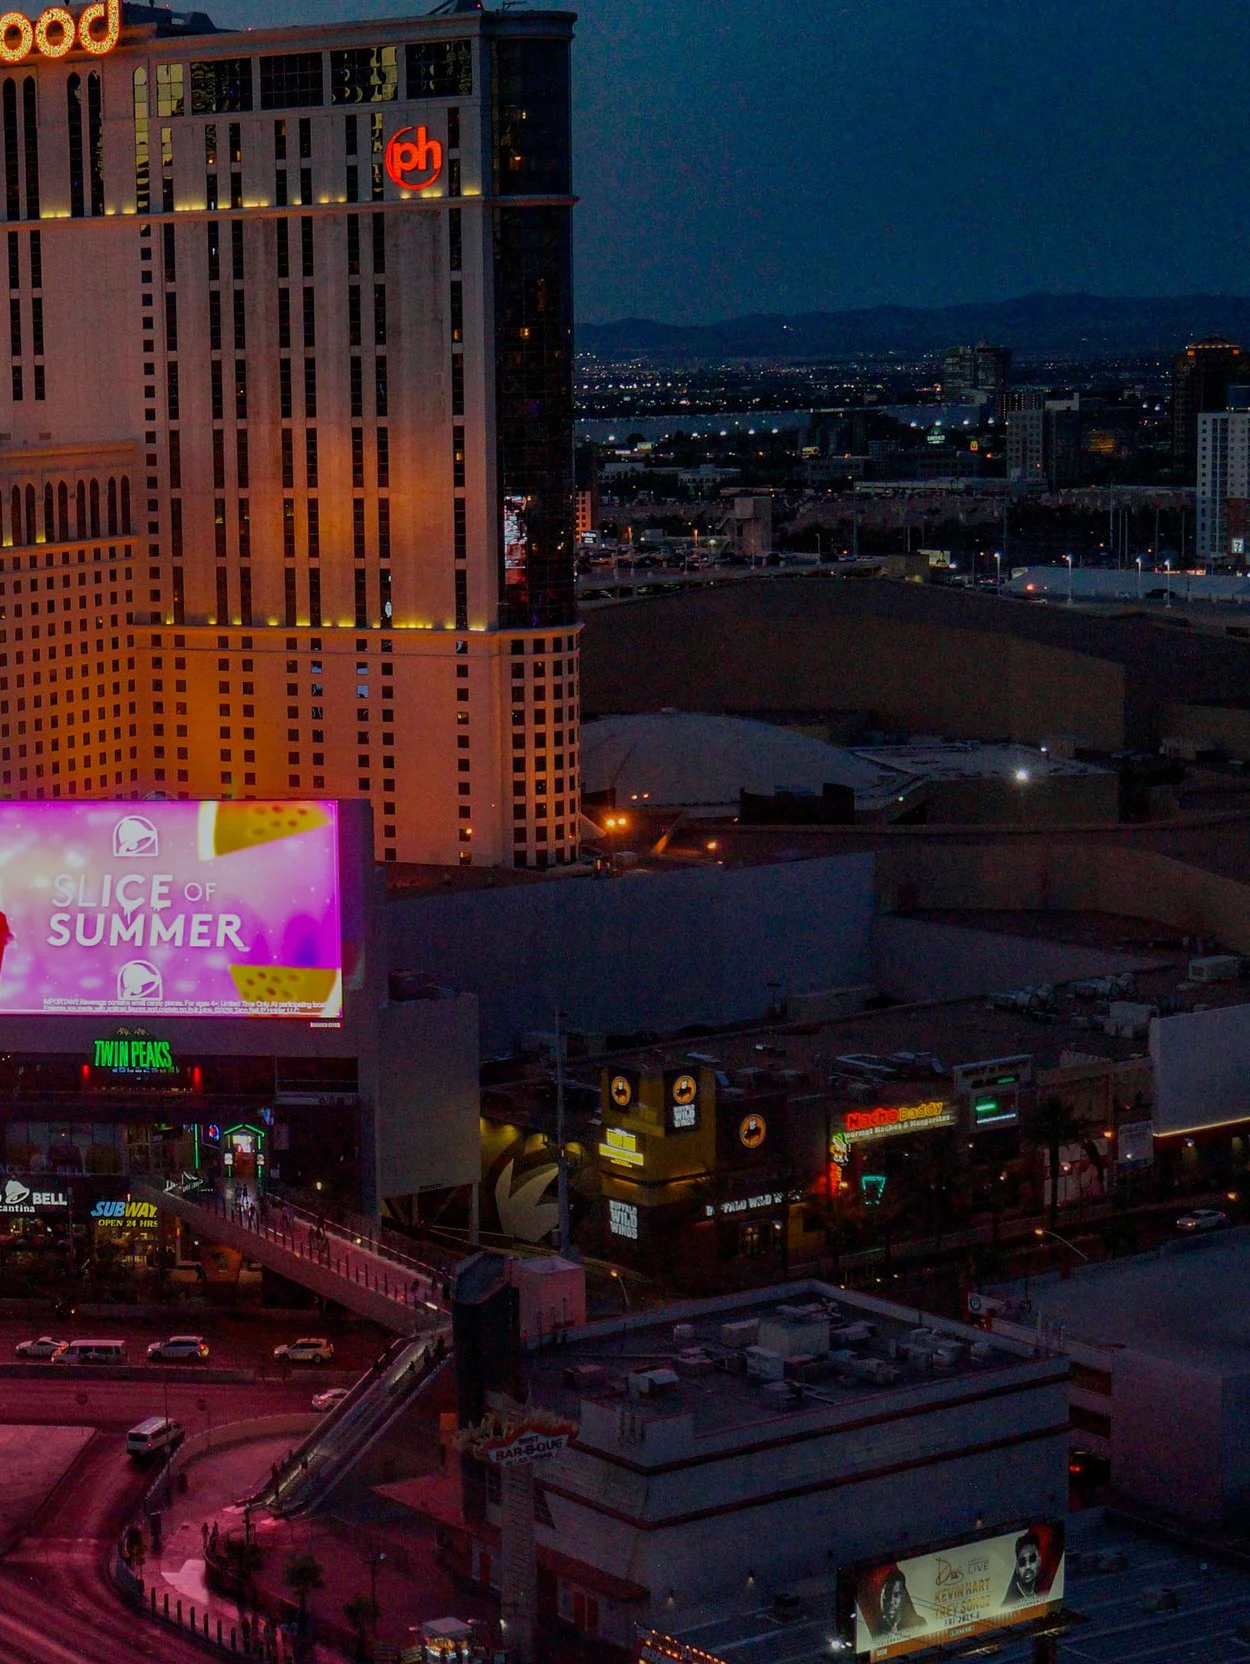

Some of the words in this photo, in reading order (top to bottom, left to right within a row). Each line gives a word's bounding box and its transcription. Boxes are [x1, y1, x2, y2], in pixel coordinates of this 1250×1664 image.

[392, 125, 443, 182] ph
[51, 873, 174, 911] SLICE
[183, 881, 217, 902] OF
[46, 912, 251, 952] SUMMER
[94, 1040, 129, 1067] TWIN
[130, 1040, 173, 1068] PEAKS
[845, 1107, 899, 1130] Nacho
[898, 1101, 943, 1121] Daddy
[32, 1192, 68, 1206] BELL
[90, 1200, 159, 1218] SUBWAY
[98, 1218, 123, 1227] OPEN
[126, 1219, 136, 1227] 24
[139, 1219, 159, 1228] HRS
[968, 1561, 990, 1575] LIVE
[964, 1577, 991, 1596] HART
